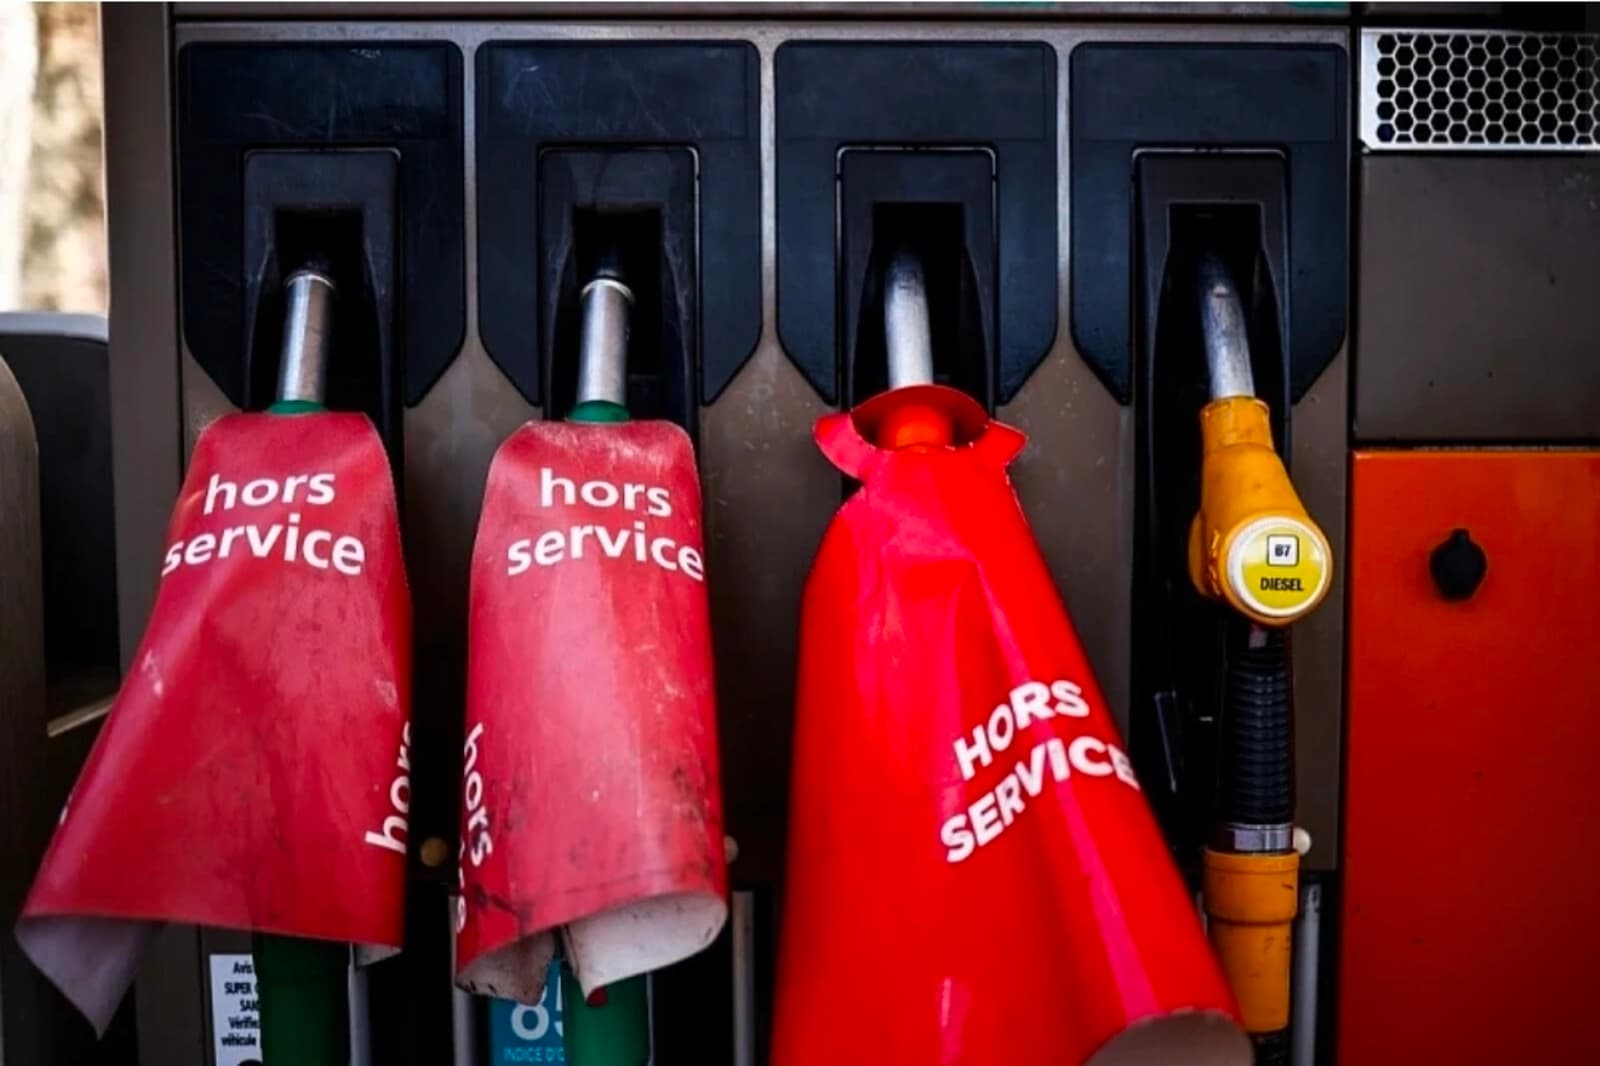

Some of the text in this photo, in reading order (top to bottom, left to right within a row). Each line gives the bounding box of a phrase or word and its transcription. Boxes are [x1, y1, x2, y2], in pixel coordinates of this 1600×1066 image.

[203, 473, 335, 516] hors
[540, 467, 673, 518] hors
[161, 513, 366, 576] service
[507, 520, 704, 582] service
[1274, 543, 1291, 557] B7
[1260, 577, 1304, 592] DIESEL
[953, 679, 1090, 781] HORS
[464, 722, 493, 867] hors
[940, 735, 1141, 863] SERVICE
[224, 982, 252, 995] SUPER
[232, 961, 253, 974] Avis
[220, 1034, 257, 1047] véhicule
[503, 1046, 543, 1062] INDICE
